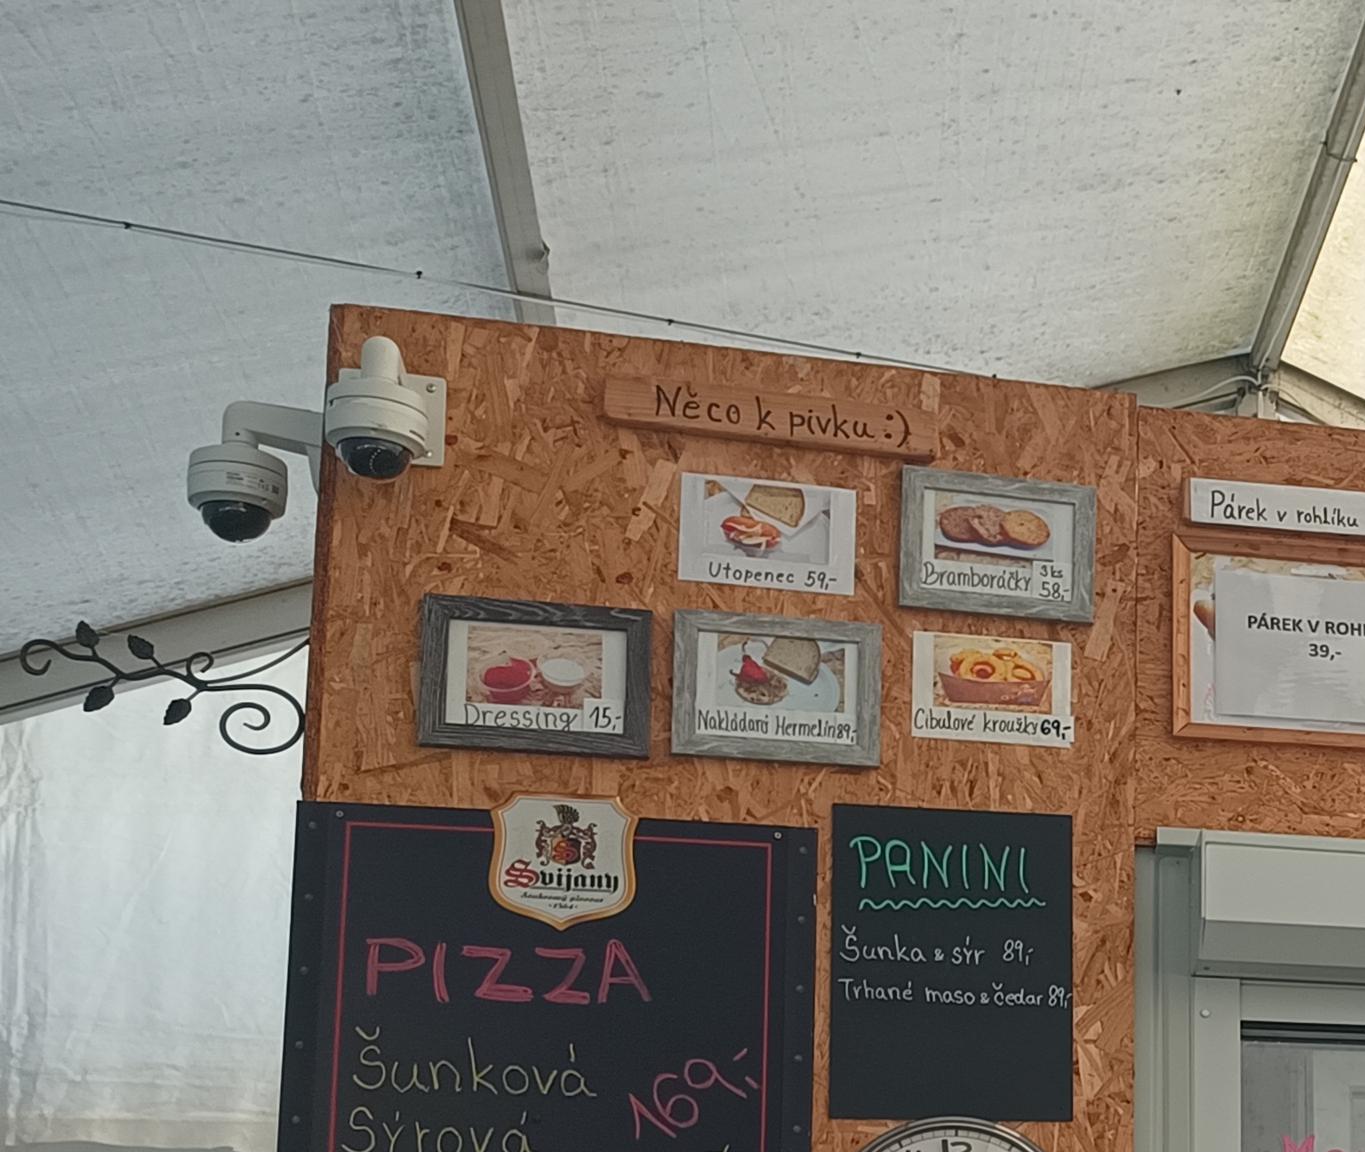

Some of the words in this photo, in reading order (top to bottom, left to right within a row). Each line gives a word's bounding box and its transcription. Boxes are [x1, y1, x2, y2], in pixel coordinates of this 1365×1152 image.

[655, 385, 741, 428] Něco
[756, 398, 776, 431] k
[790, 405, 871, 440] pivku
[1210, 488, 1267, 521] Párek
[1277, 510, 1287, 521] v
[1296, 506, 1360, 529] rohlíku
[708, 561, 795, 586] Utopenec
[804, 571, 837, 592] 59,-
[922, 561, 1031, 592] Bramboráčky
[1039, 582, 1070, 601] 58,-
[1247, 612, 1303, 634] PÁREK
[1306, 619, 1319, 634] V
[1308, 643, 1343, 661] 39,-
[464, 703, 578, 731] Dressing
[588, 706, 622, 732] 15,-
[914, 708, 976, 730] Cibulové
[983, 712, 1038, 735] kroužky
[1040, 720, 1072, 740] 69,-
[504, 859, 619, 894] Svijany
[850, 836, 1029, 894] PANINI
[840, 924, 927, 963] Šunka
[951, 936, 986, 965] sýr
[366, 936, 652, 1006] PIZZA
[838, 978, 913, 1001] Trhané
[925, 986, 976, 1005] maso
[992, 982, 1043, 1007] čedar
[352, 1026, 599, 1098] Šunková
